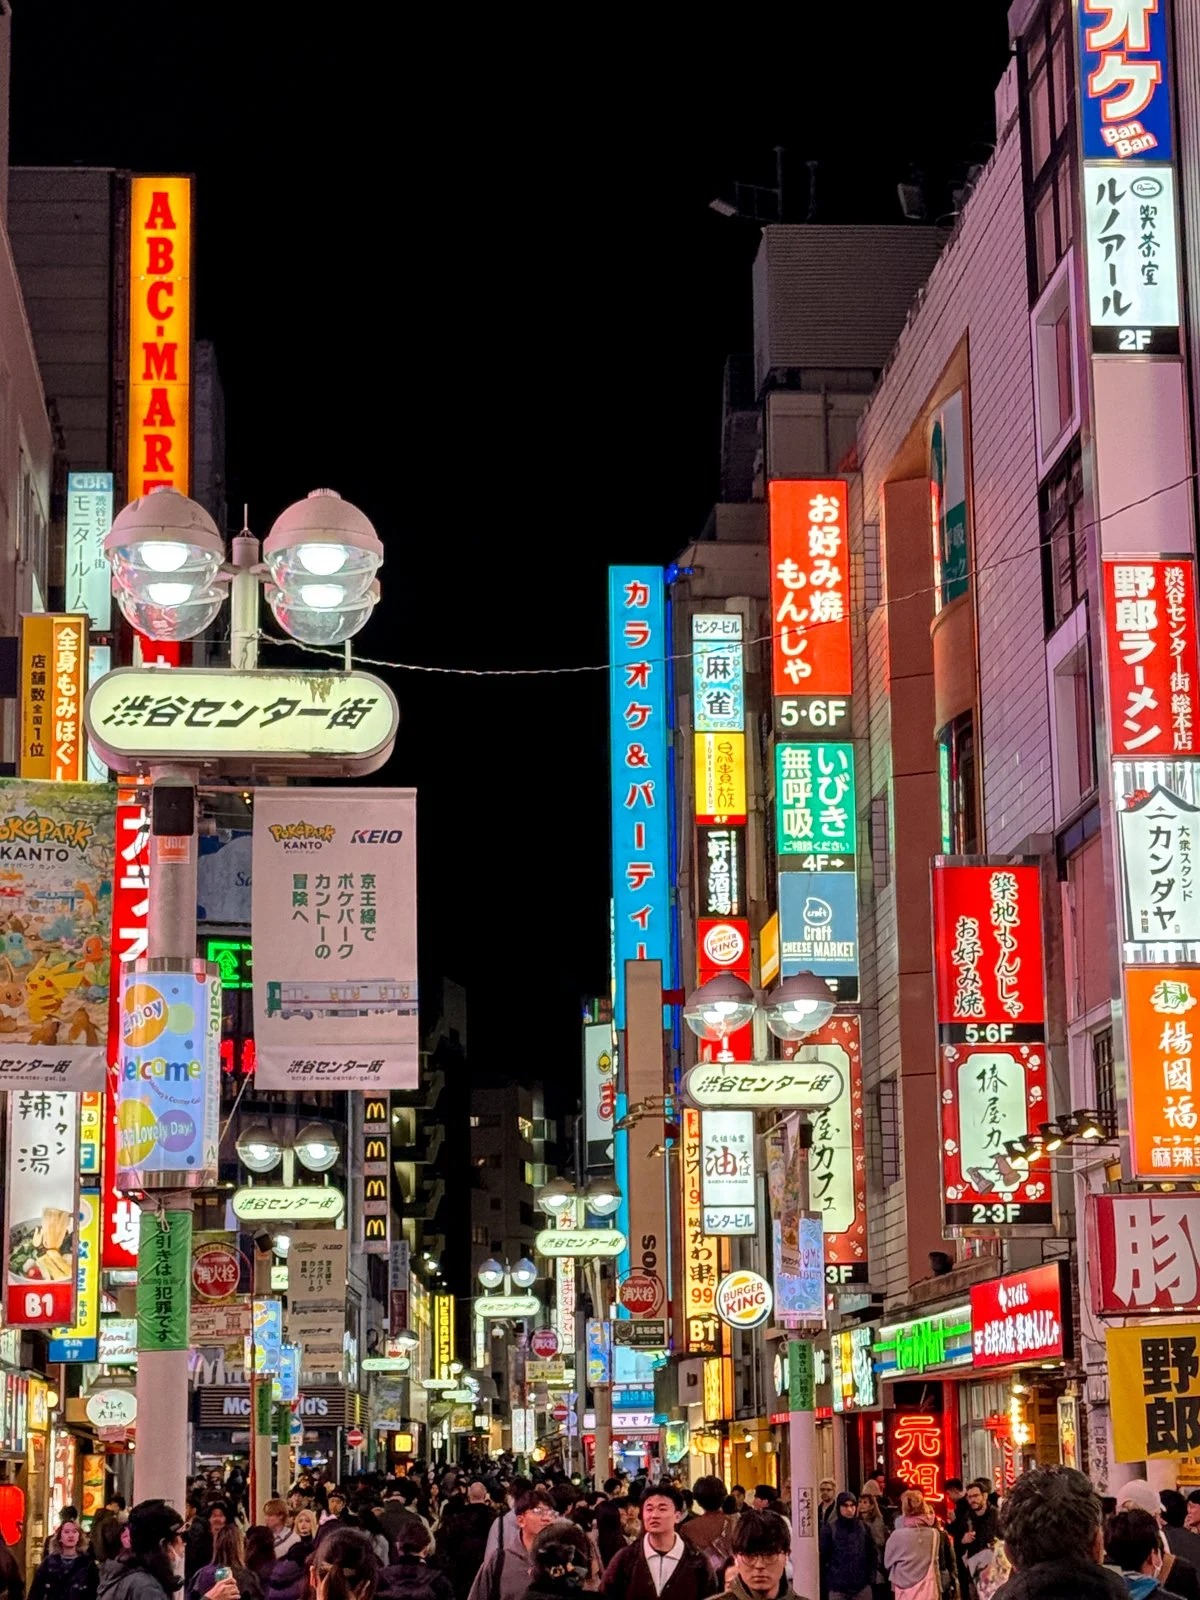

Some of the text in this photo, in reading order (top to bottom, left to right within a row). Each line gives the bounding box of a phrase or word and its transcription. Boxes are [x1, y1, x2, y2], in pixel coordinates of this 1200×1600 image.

[1104, 124, 1142, 143] Ban
[1119, 134, 1154, 156] Ban
[1097, 178, 1132, 317] ルノアール
[143, 191, 177, 494] ABC-MAR
[1118, 329, 1151, 350] 2F
[71, 495, 90, 611] モニタールーム
[808, 494, 843, 622] お好み焼
[695, 620, 740, 634] センタービル
[776, 558, 812, 685] もんじゃ
[1113, 566, 1162, 751] 野郎ラーメン
[705, 655, 732, 716] 麻雀
[102, 695, 378, 730] 渋谷センター街
[781, 748, 814, 838] 無呼吸
[817, 747, 849, 837] いびき
[284, 841, 322, 850] KANTO
[351, 830, 403, 844] KEIO
[0, 846, 69, 862] KANTO
[802, 854, 829, 872] 4F
[1178, 826, 1193, 902] 大衆スタンド
[707, 830, 731, 915] 一軒め酒場
[1149, 826, 1177, 930] カンダヤ
[292, 874, 309, 923] 冒険へ
[360, 873, 377, 941] 京王線で
[315, 874, 331, 959] カントーの
[337, 873, 354, 959] ポケパーク
[711, 942, 738, 954] KING
[803, 925, 832, 941] Craft
[991, 873, 1024, 1018] 築地もんじゃ
[782, 942, 855, 957] CHEESE MARKET
[952, 916, 985, 1016] お好み焼
[122, 999, 163, 1038] Enjoy
[286, 1060, 385, 1073] 渋谷センター街
[1159, 1021, 1198, 1130] 楊國福
[697, 1075, 834, 1092] 渋谷センター街
[705, 1145, 751, 1176] 油 そば
[238, 1197, 335, 1211] 渋谷センター街
[706, 1214, 753, 1228] センタービル
[197, 1265, 236, 1285] 消火栓
[24, 1293, 54, 1317] B1
[622, 1286, 654, 1302] 消火栓
[691, 1287, 713, 1304] 99
[723, 1282, 763, 1301] BURGER
[725, 1293, 766, 1318] KING
[689, 1320, 716, 1342] B1
[222, 1397, 328, 1416] Mcld's
[1141, 1337, 1200, 1456] 野郎
[895, 1416, 944, 1502] 元祖
